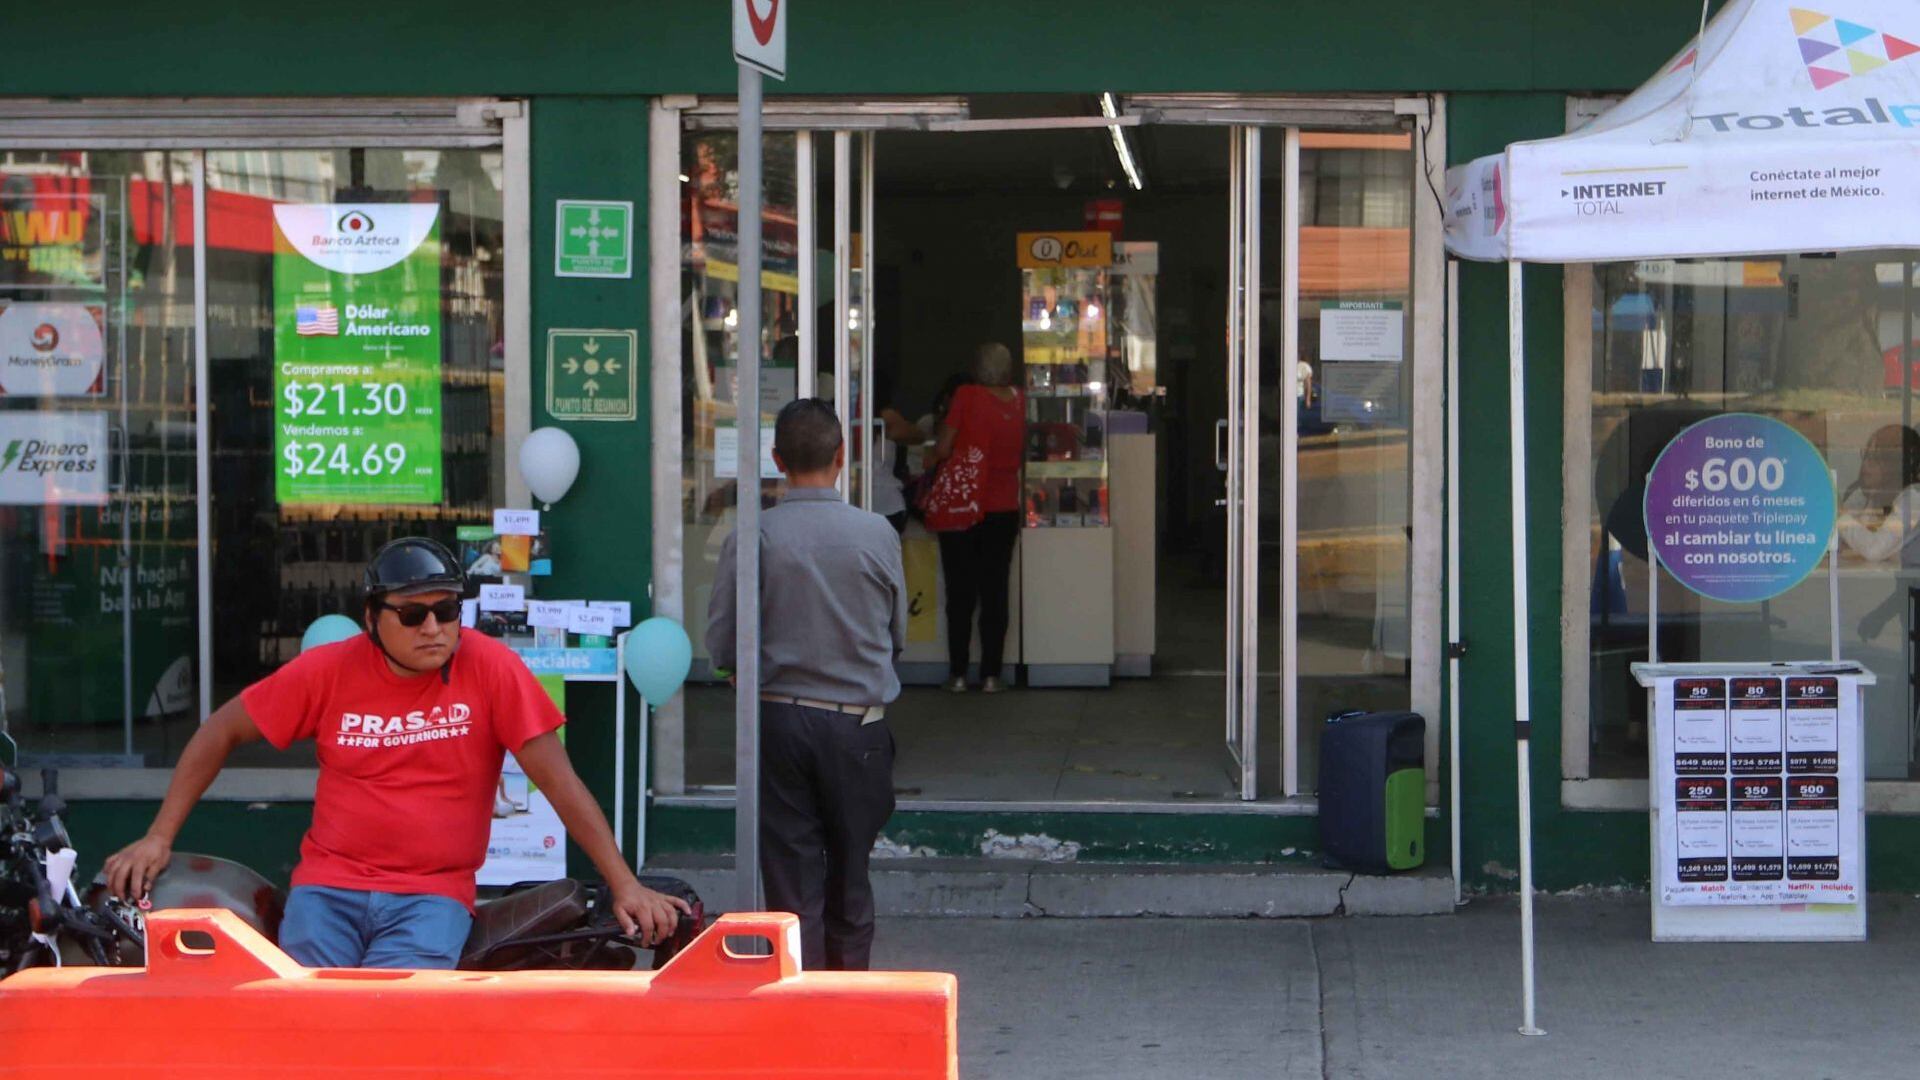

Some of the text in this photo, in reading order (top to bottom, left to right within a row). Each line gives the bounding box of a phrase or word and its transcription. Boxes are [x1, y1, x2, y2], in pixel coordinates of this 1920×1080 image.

[1750, 166, 1880, 182] Conéctate al mejor
[1573, 181, 1666, 200] INTERNET
[1750, 185, 1885, 201] internet de México.
[1574, 200, 1624, 216] TOTAL
[312, 235, 400, 247] Banco Azteca
[345, 303, 389, 319] Dólar
[1339, 301, 1384, 311] IMPORTANTE
[345, 321, 431, 337] Americano
[8, 356, 82, 370] MoneyGram
[281, 362, 374, 377] Compramos a:
[283, 379, 408, 418] $21.30
[555, 397, 581, 413] PUNTO
[582, 397, 592, 413] DE
[282, 424, 364, 436] Vendemos a:
[25, 440, 89, 457] Dinero
[1704, 436, 1764, 449] Bono de
[283, 439, 407, 479] $24.69
[18, 458, 96, 477] Express
[1672, 495, 1805, 508] diferidos en 6 meses
[1665, 511, 1808, 527] en tu paquete Triplepay
[1665, 530, 1816, 546] al cambiar tu línea
[1684, 551, 1796, 565] con nosotros.
[1692, 687, 1708, 696] 50
[1747, 686, 1764, 695] 80
[1800, 685, 1824, 695] 150
[341, 703, 471, 735] PRASAD
[355, 728, 449, 748] FOR GOVERNOR
[1688, 786, 1713, 796] 250
[1744, 786, 1769, 795] 350
[1799, 785, 1824, 794] 500
[1788, 883, 1815, 891] Netflix
